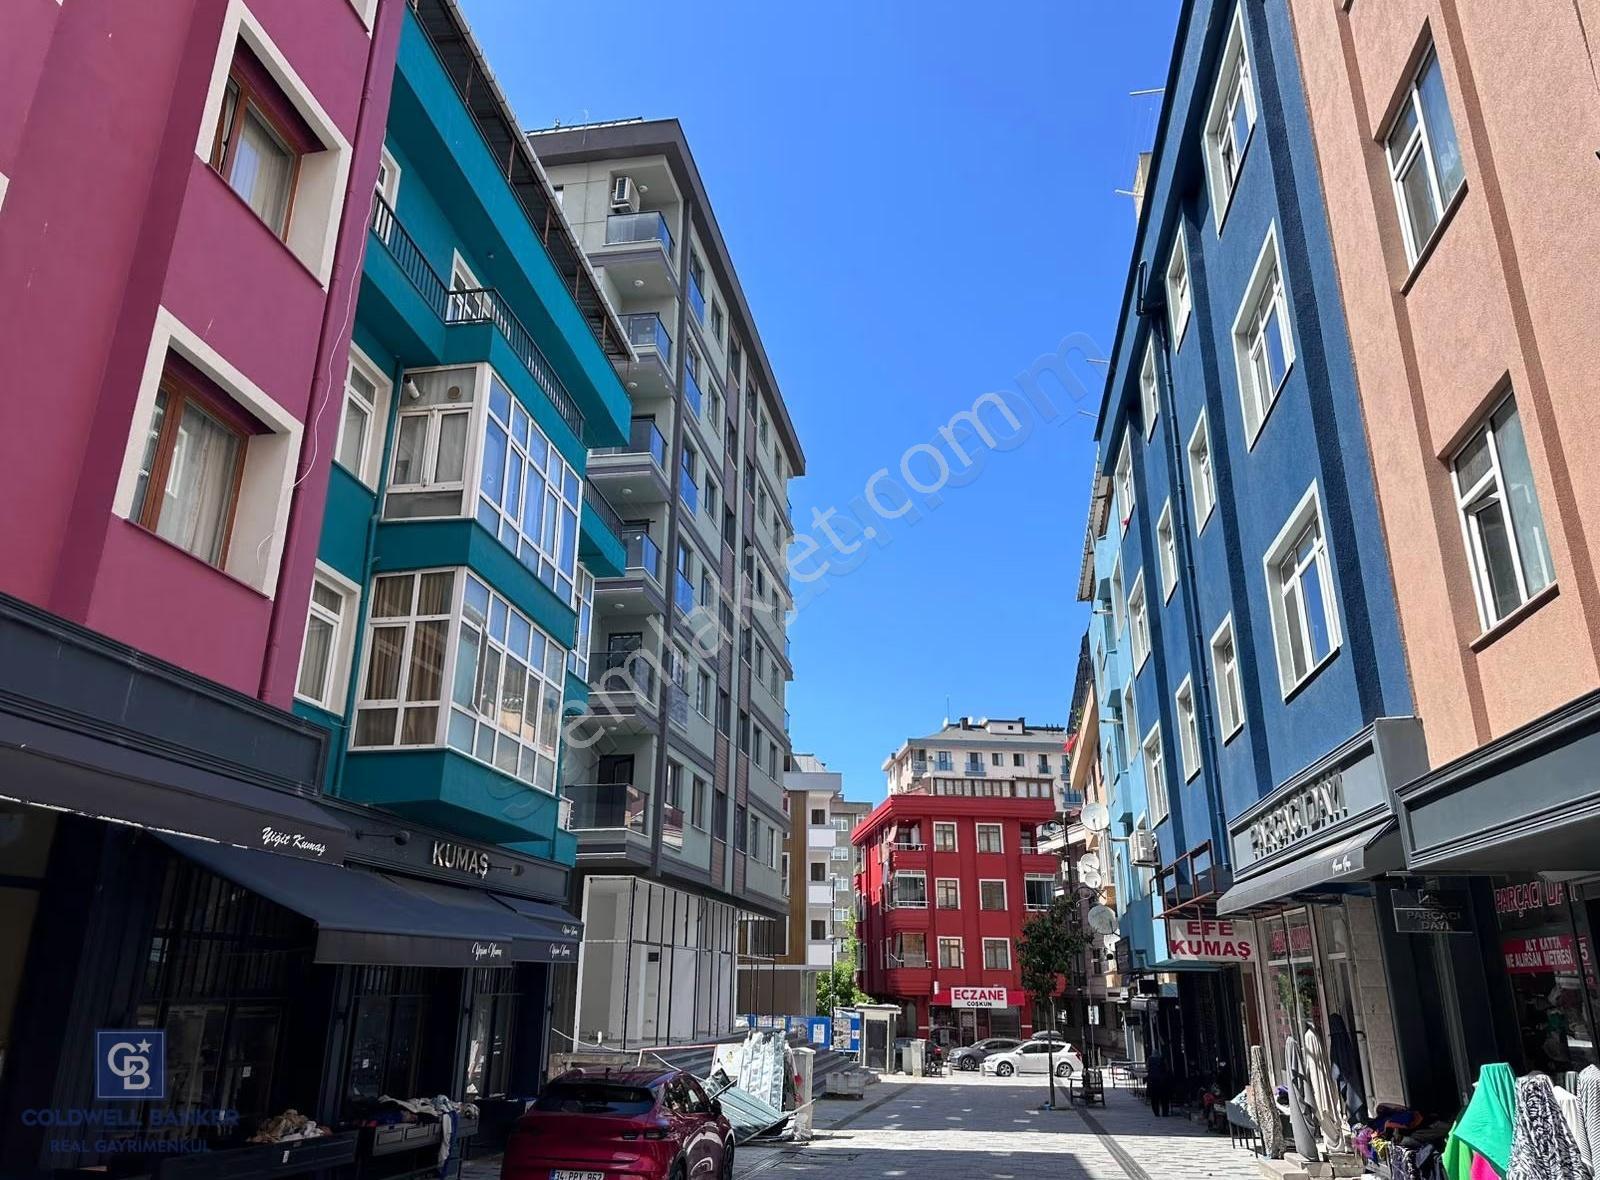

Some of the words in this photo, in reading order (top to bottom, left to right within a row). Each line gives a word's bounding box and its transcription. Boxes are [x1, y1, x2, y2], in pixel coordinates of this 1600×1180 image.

[262, 826, 291, 847] Yiğit
[292, 834, 327, 857] Kumaş
[432, 840, 489, 879] KUMAŞ
[1493, 880, 1543, 918] PARÇACI
[1187, 921, 1234, 937] EFE
[1170, 939, 1251, 961] KUMAŞ
[1525, 938, 1538, 951] ALT
[1505, 953, 1515, 969] NE
[1515, 950, 1543, 968] ALIRSAN
[954, 989, 1004, 1001] ECZANE
